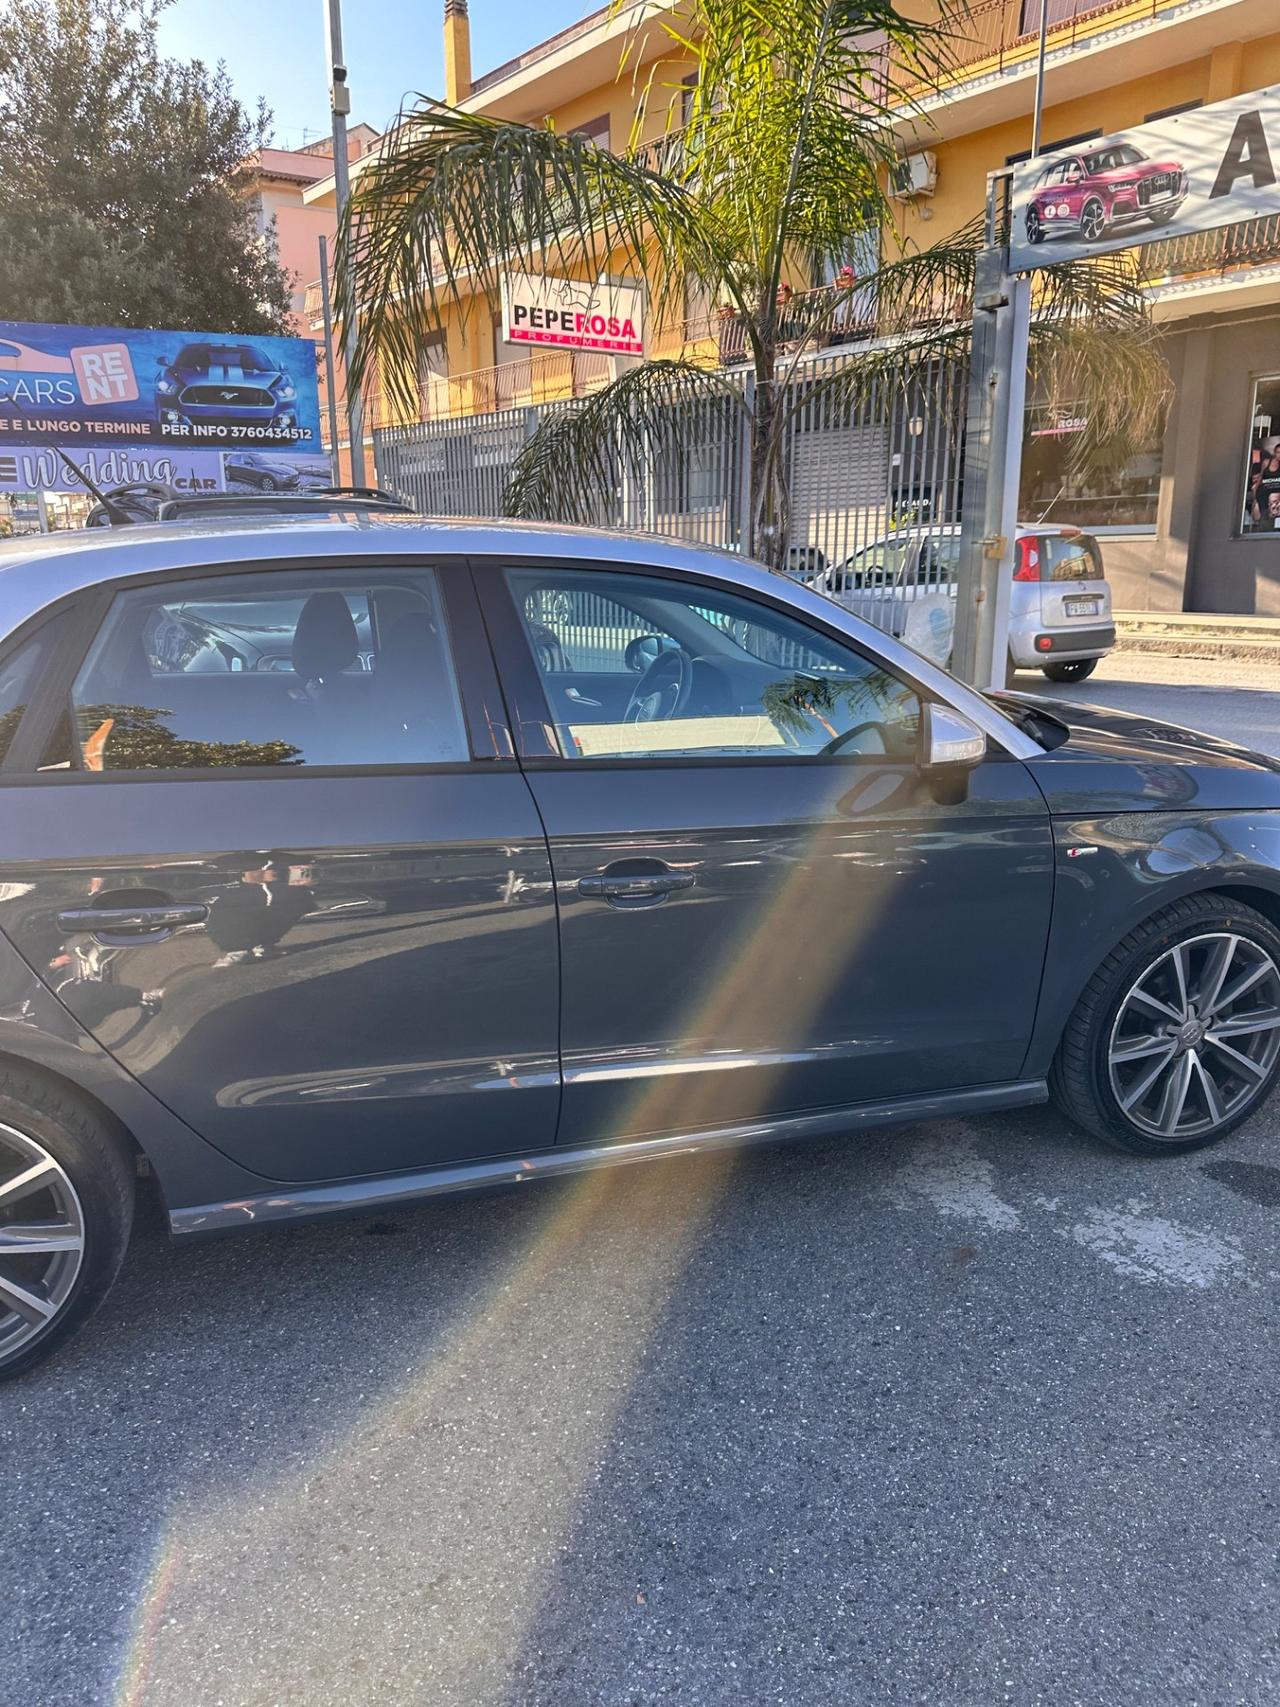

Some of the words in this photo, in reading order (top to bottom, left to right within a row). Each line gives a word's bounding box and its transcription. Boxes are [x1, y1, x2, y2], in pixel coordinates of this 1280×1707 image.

[1209, 110, 1277, 199] A
[514, 305, 636, 339] PEPEROSA
[514, 330, 638, 351] PROFUMERIE
[13, 419, 23, 431] E
[27, 420, 81, 432] LUNGO
[84, 421, 151, 434] TERMINE
[161, 423, 189, 437] PER
[193, 424, 228, 438] INFO
[230, 425, 312, 440] 3760434512
[22, 449, 176, 489] Wedding
[175, 477, 217, 490] CAR
